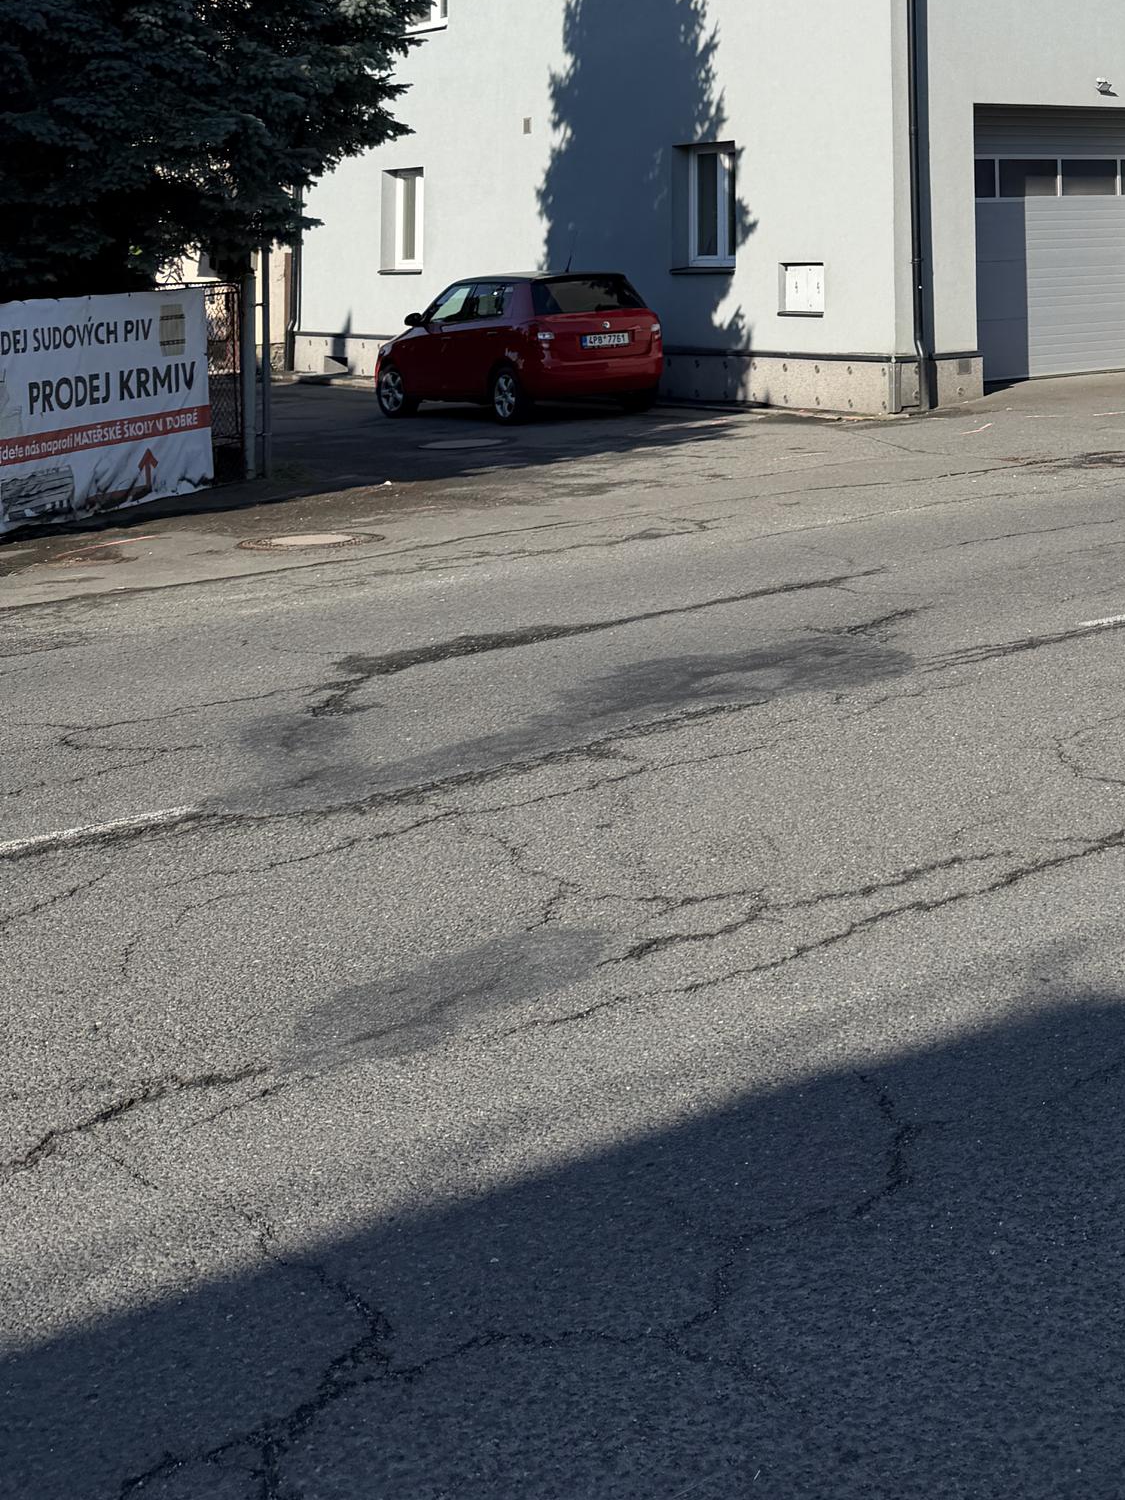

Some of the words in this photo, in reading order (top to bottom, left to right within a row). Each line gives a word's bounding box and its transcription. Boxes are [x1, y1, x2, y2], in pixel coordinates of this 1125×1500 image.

[0, 329, 28, 356] DEJ
[32, 316, 118, 352] SUDOVÝCH
[123, 318, 153, 342] PIV
[28, 372, 111, 415] PRODEJ
[118, 361, 196, 401] KRMIV
[24, 441, 40, 456] nás
[40, 437, 73, 454] naproti
[73, 423, 122, 447] MATEŘSKÉ
[123, 420, 155, 438] ŠKOLY
[165, 408, 198, 430] DOBRÉ
